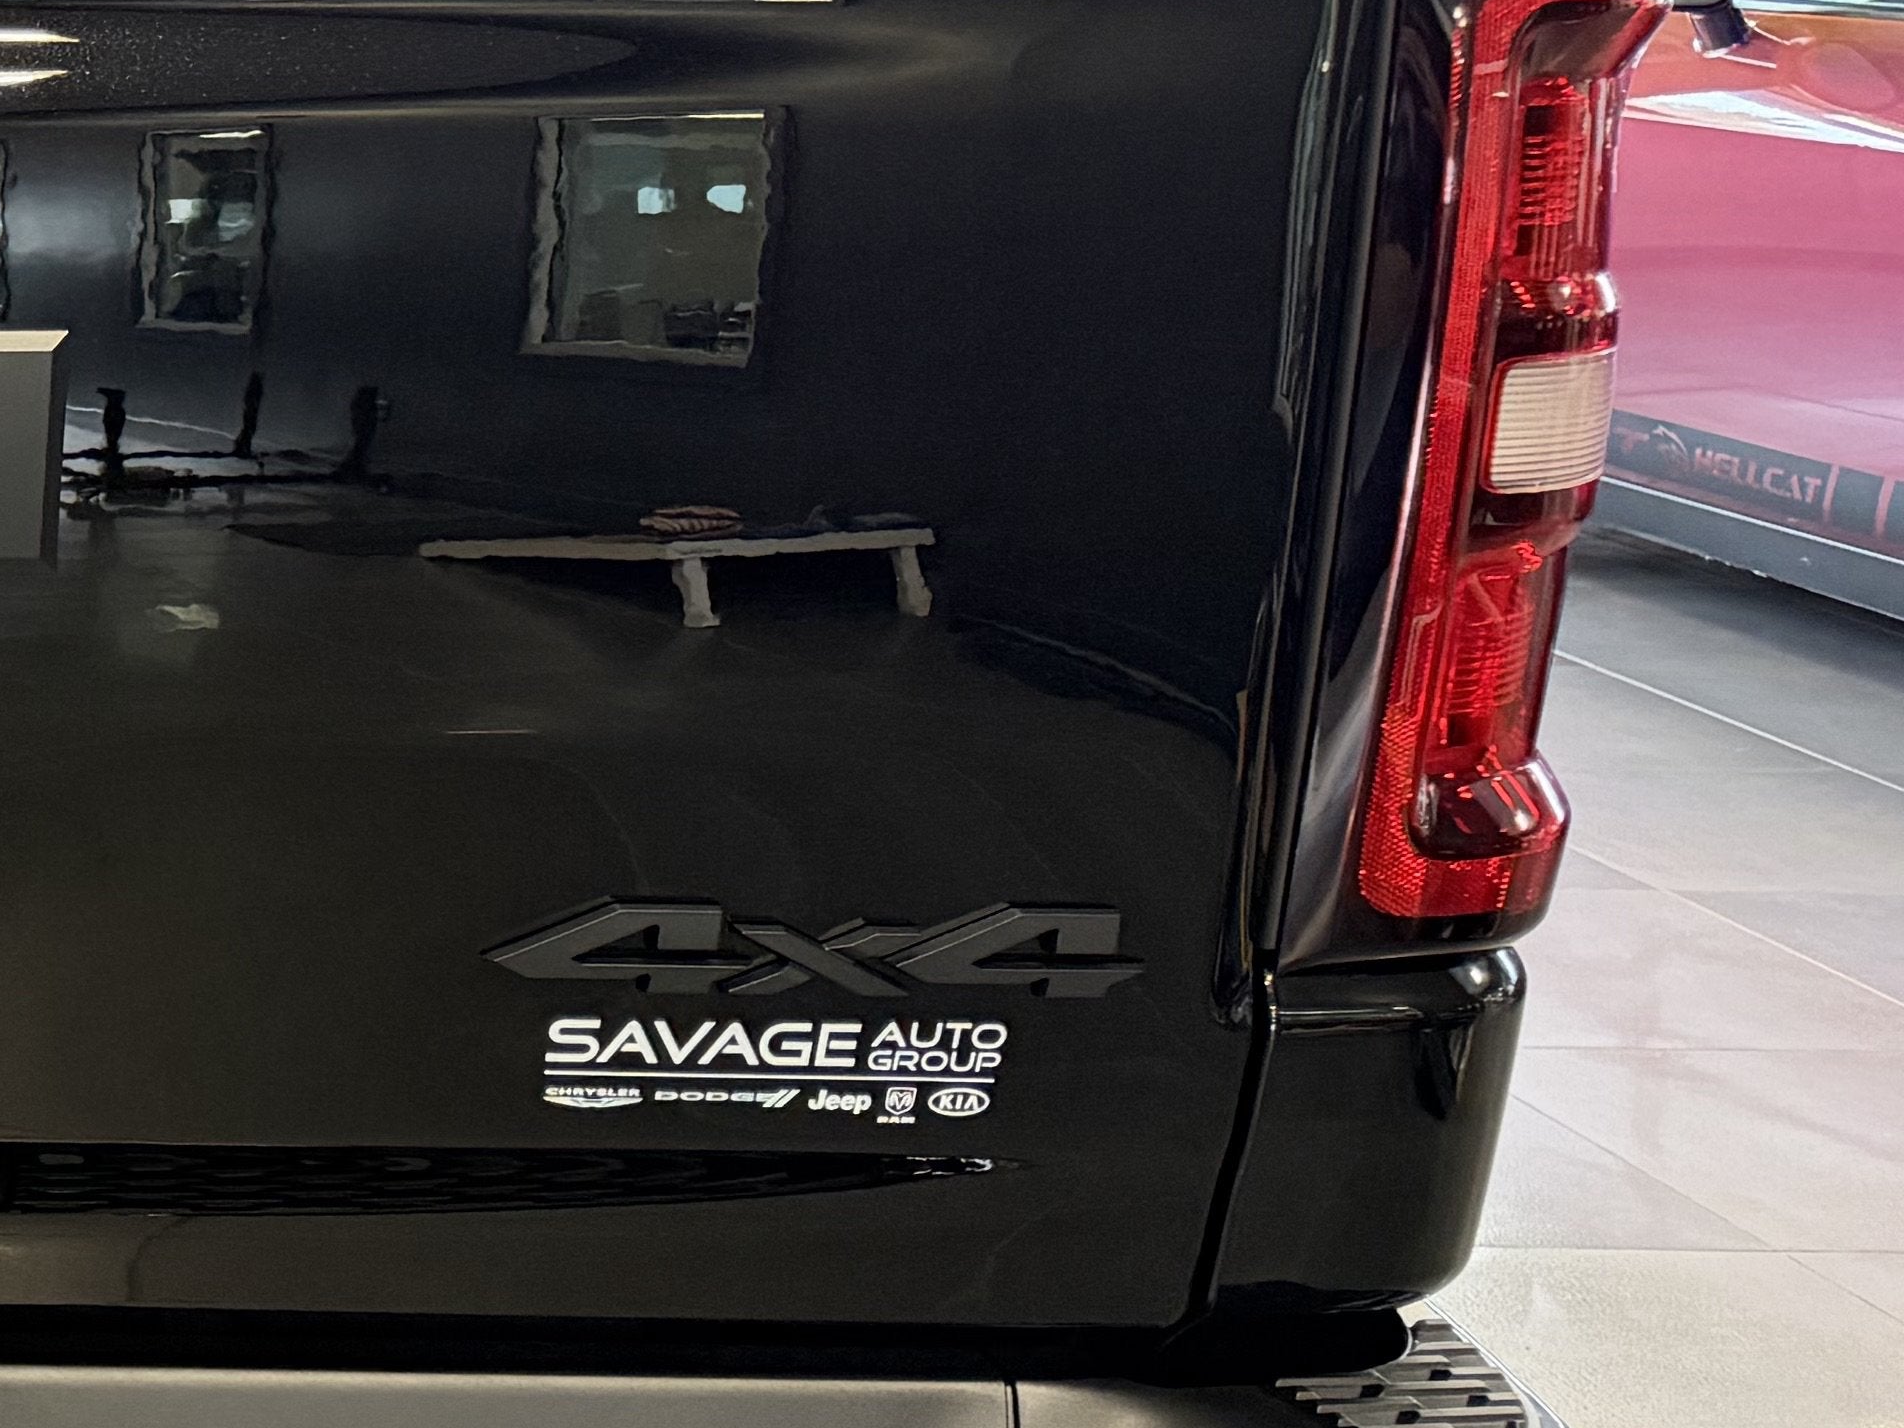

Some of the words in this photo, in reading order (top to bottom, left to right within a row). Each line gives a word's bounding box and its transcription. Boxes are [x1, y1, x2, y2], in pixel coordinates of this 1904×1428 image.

[1694, 446, 1822, 504] HELLCAT
[544, 1018, 863, 1067] SAVAGE
[870, 1021, 1009, 1049] AUTO
[867, 1050, 1003, 1072] GROUP
[545, 1087, 641, 1097] CHRYSLER
[654, 1089, 780, 1104] DODGE
[807, 1088, 873, 1115] Jeep
